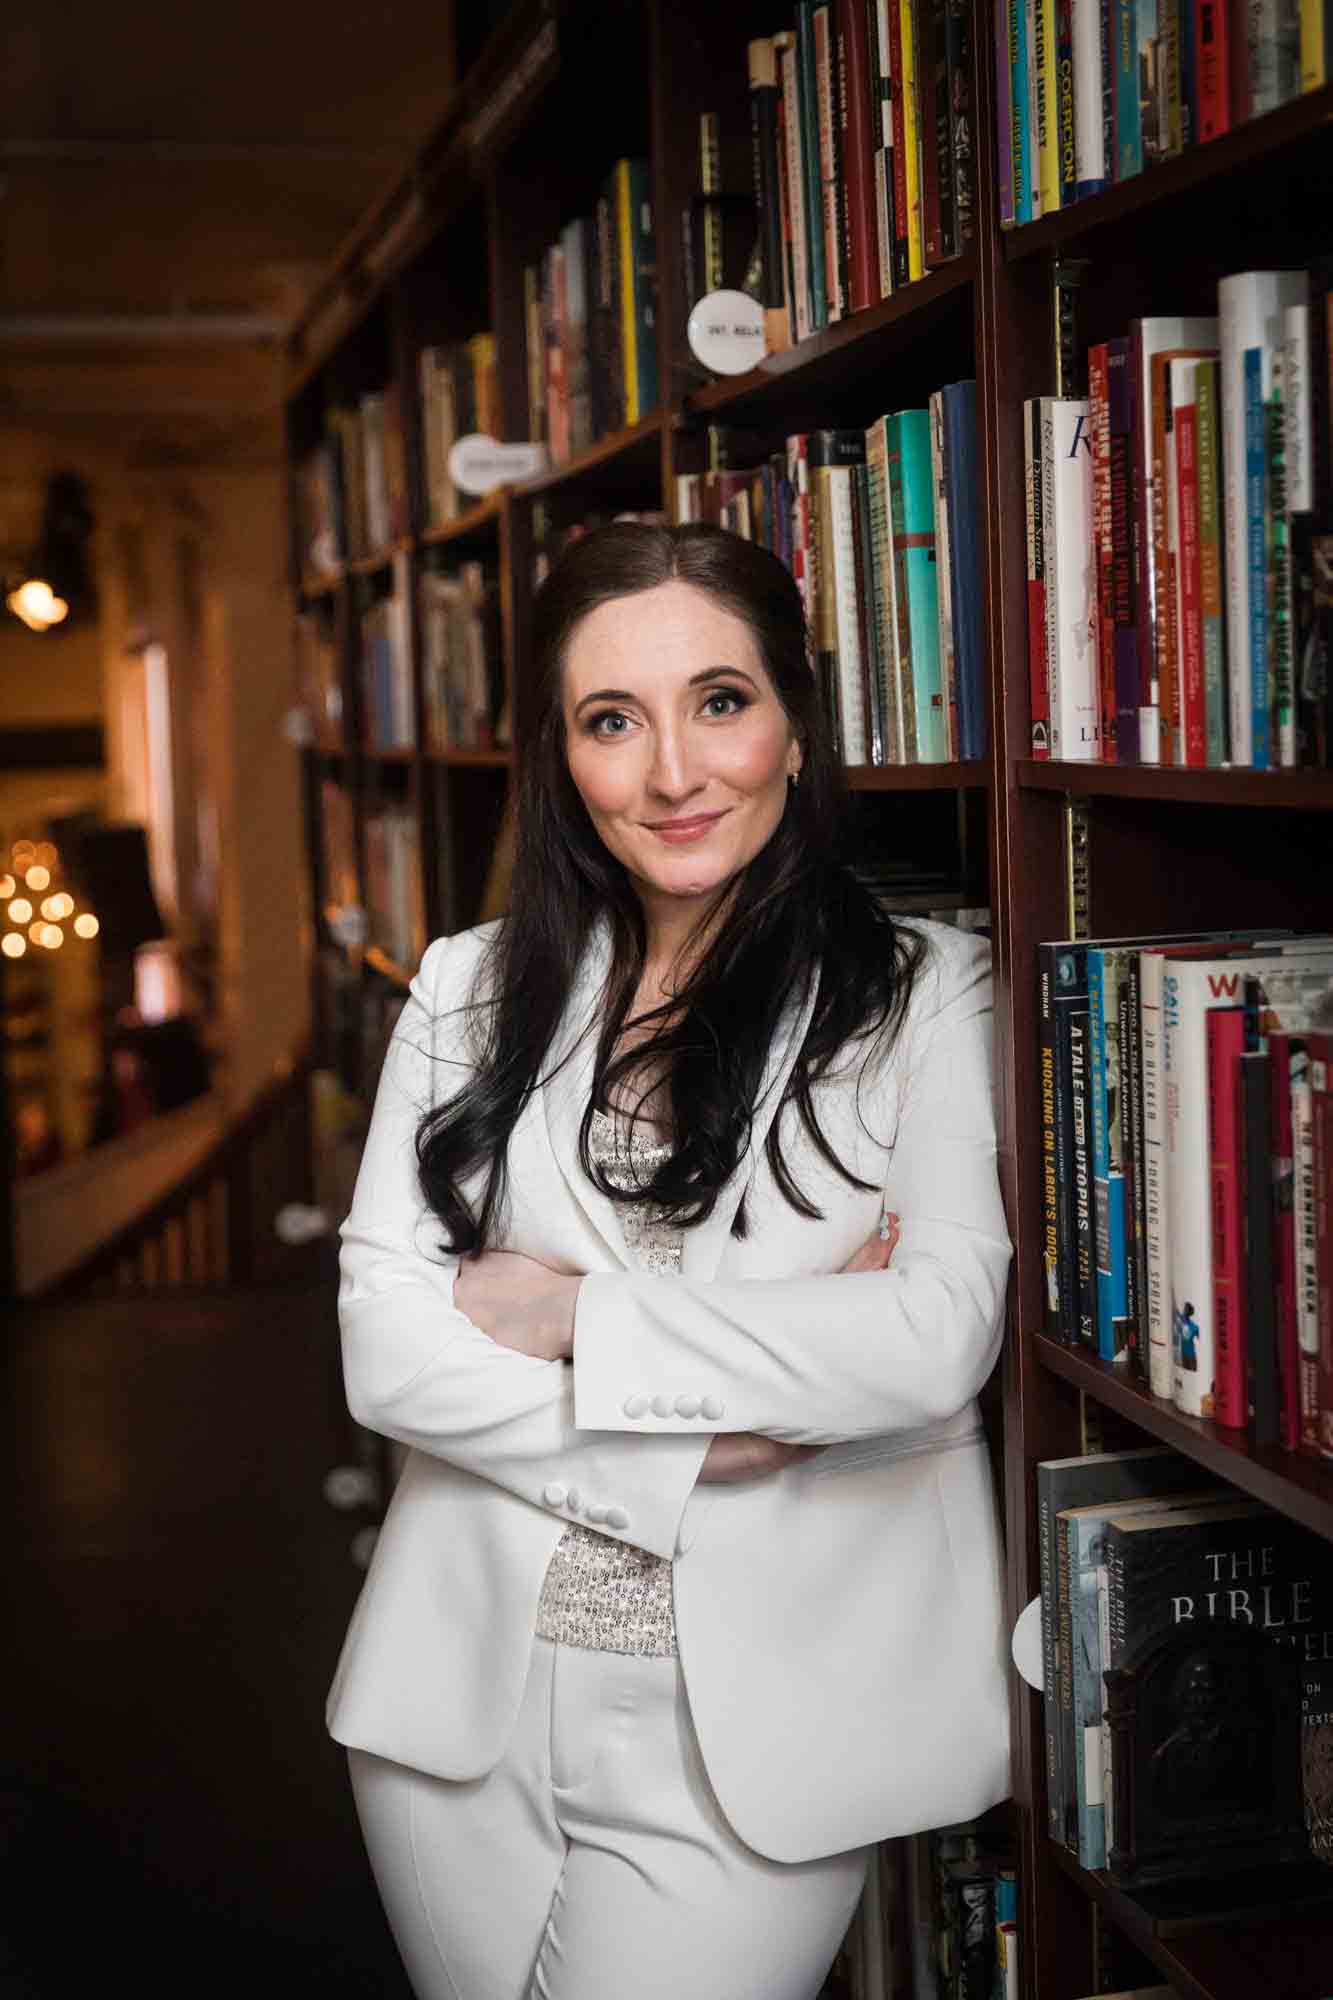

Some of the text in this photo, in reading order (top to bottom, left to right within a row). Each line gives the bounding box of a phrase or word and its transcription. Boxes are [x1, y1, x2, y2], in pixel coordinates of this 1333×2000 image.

[1060, 58, 1076, 184] COERCION
[1033, 457, 1043, 521] Division
[1043, 419, 1055, 531] Reckoning
[1153, 457, 1168, 667] ENEMY ALIENS
[1041, 972, 1049, 1018] WINDHAM
[1071, 1024, 1084, 1038] A
[1128, 972, 1138, 1026] #METOO
[1071, 1043, 1086, 1090] TALE
[1118, 1000, 1129, 1142] Unwanted Advances
[1130, 1031, 1138, 1045] IN
[1143, 1028, 1157, 1120] JO BECKER
[1041, 1047, 1054, 1125] KNOCKING
[1131, 1074, 1141, 1157] CORPORATE
[1043, 1130, 1055, 1151] ON
[1044, 1155, 1056, 1220] LABOR'S
[1075, 1149, 1089, 1231] UTOPIAS
[1133, 1161, 1142, 1210] WORLD
[1302, 1162, 1316, 1249] TURNING
[1147, 1159, 1161, 1329] FORCING THE SPRING
[1040, 1500, 1052, 1608] SHIPWRECKED
[1205, 1546, 1276, 1583] THE
[1114, 1557, 1126, 1650] THE BIBLE
[1171, 1580, 1313, 1628] BIBLE
